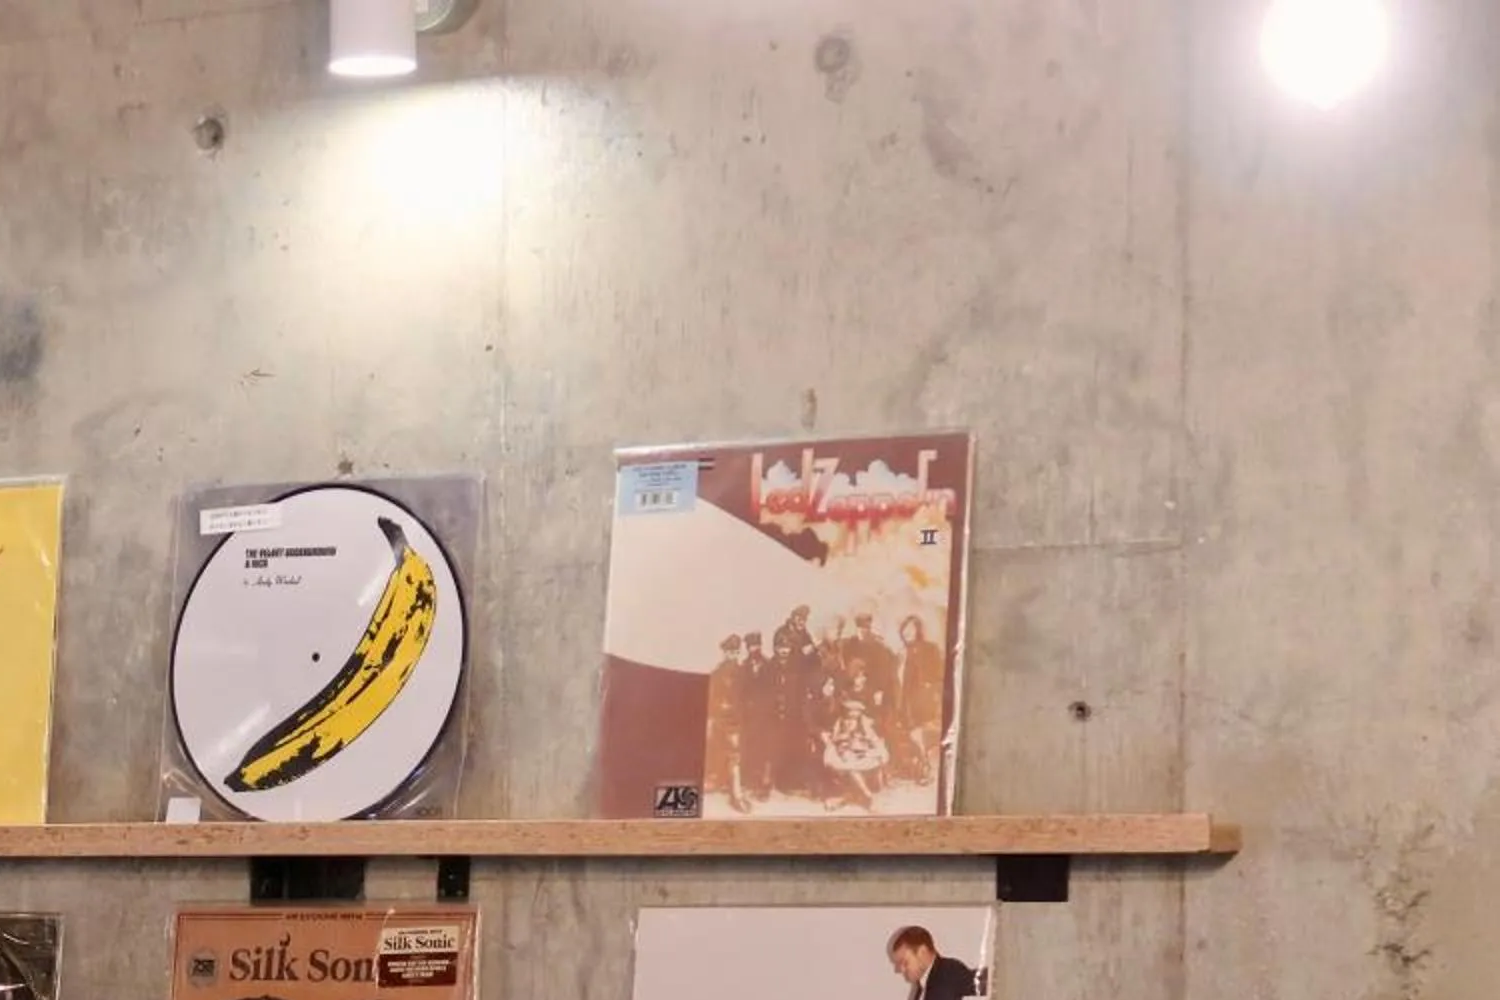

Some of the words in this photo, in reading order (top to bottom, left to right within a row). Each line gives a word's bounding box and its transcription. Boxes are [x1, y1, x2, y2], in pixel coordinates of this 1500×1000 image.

[920, 529, 938, 545] II
[384, 936, 412, 950] Silk
[415, 933, 455, 949] Sonic
[229, 932, 299, 981] Silk
[307, 949, 376, 982] Son
